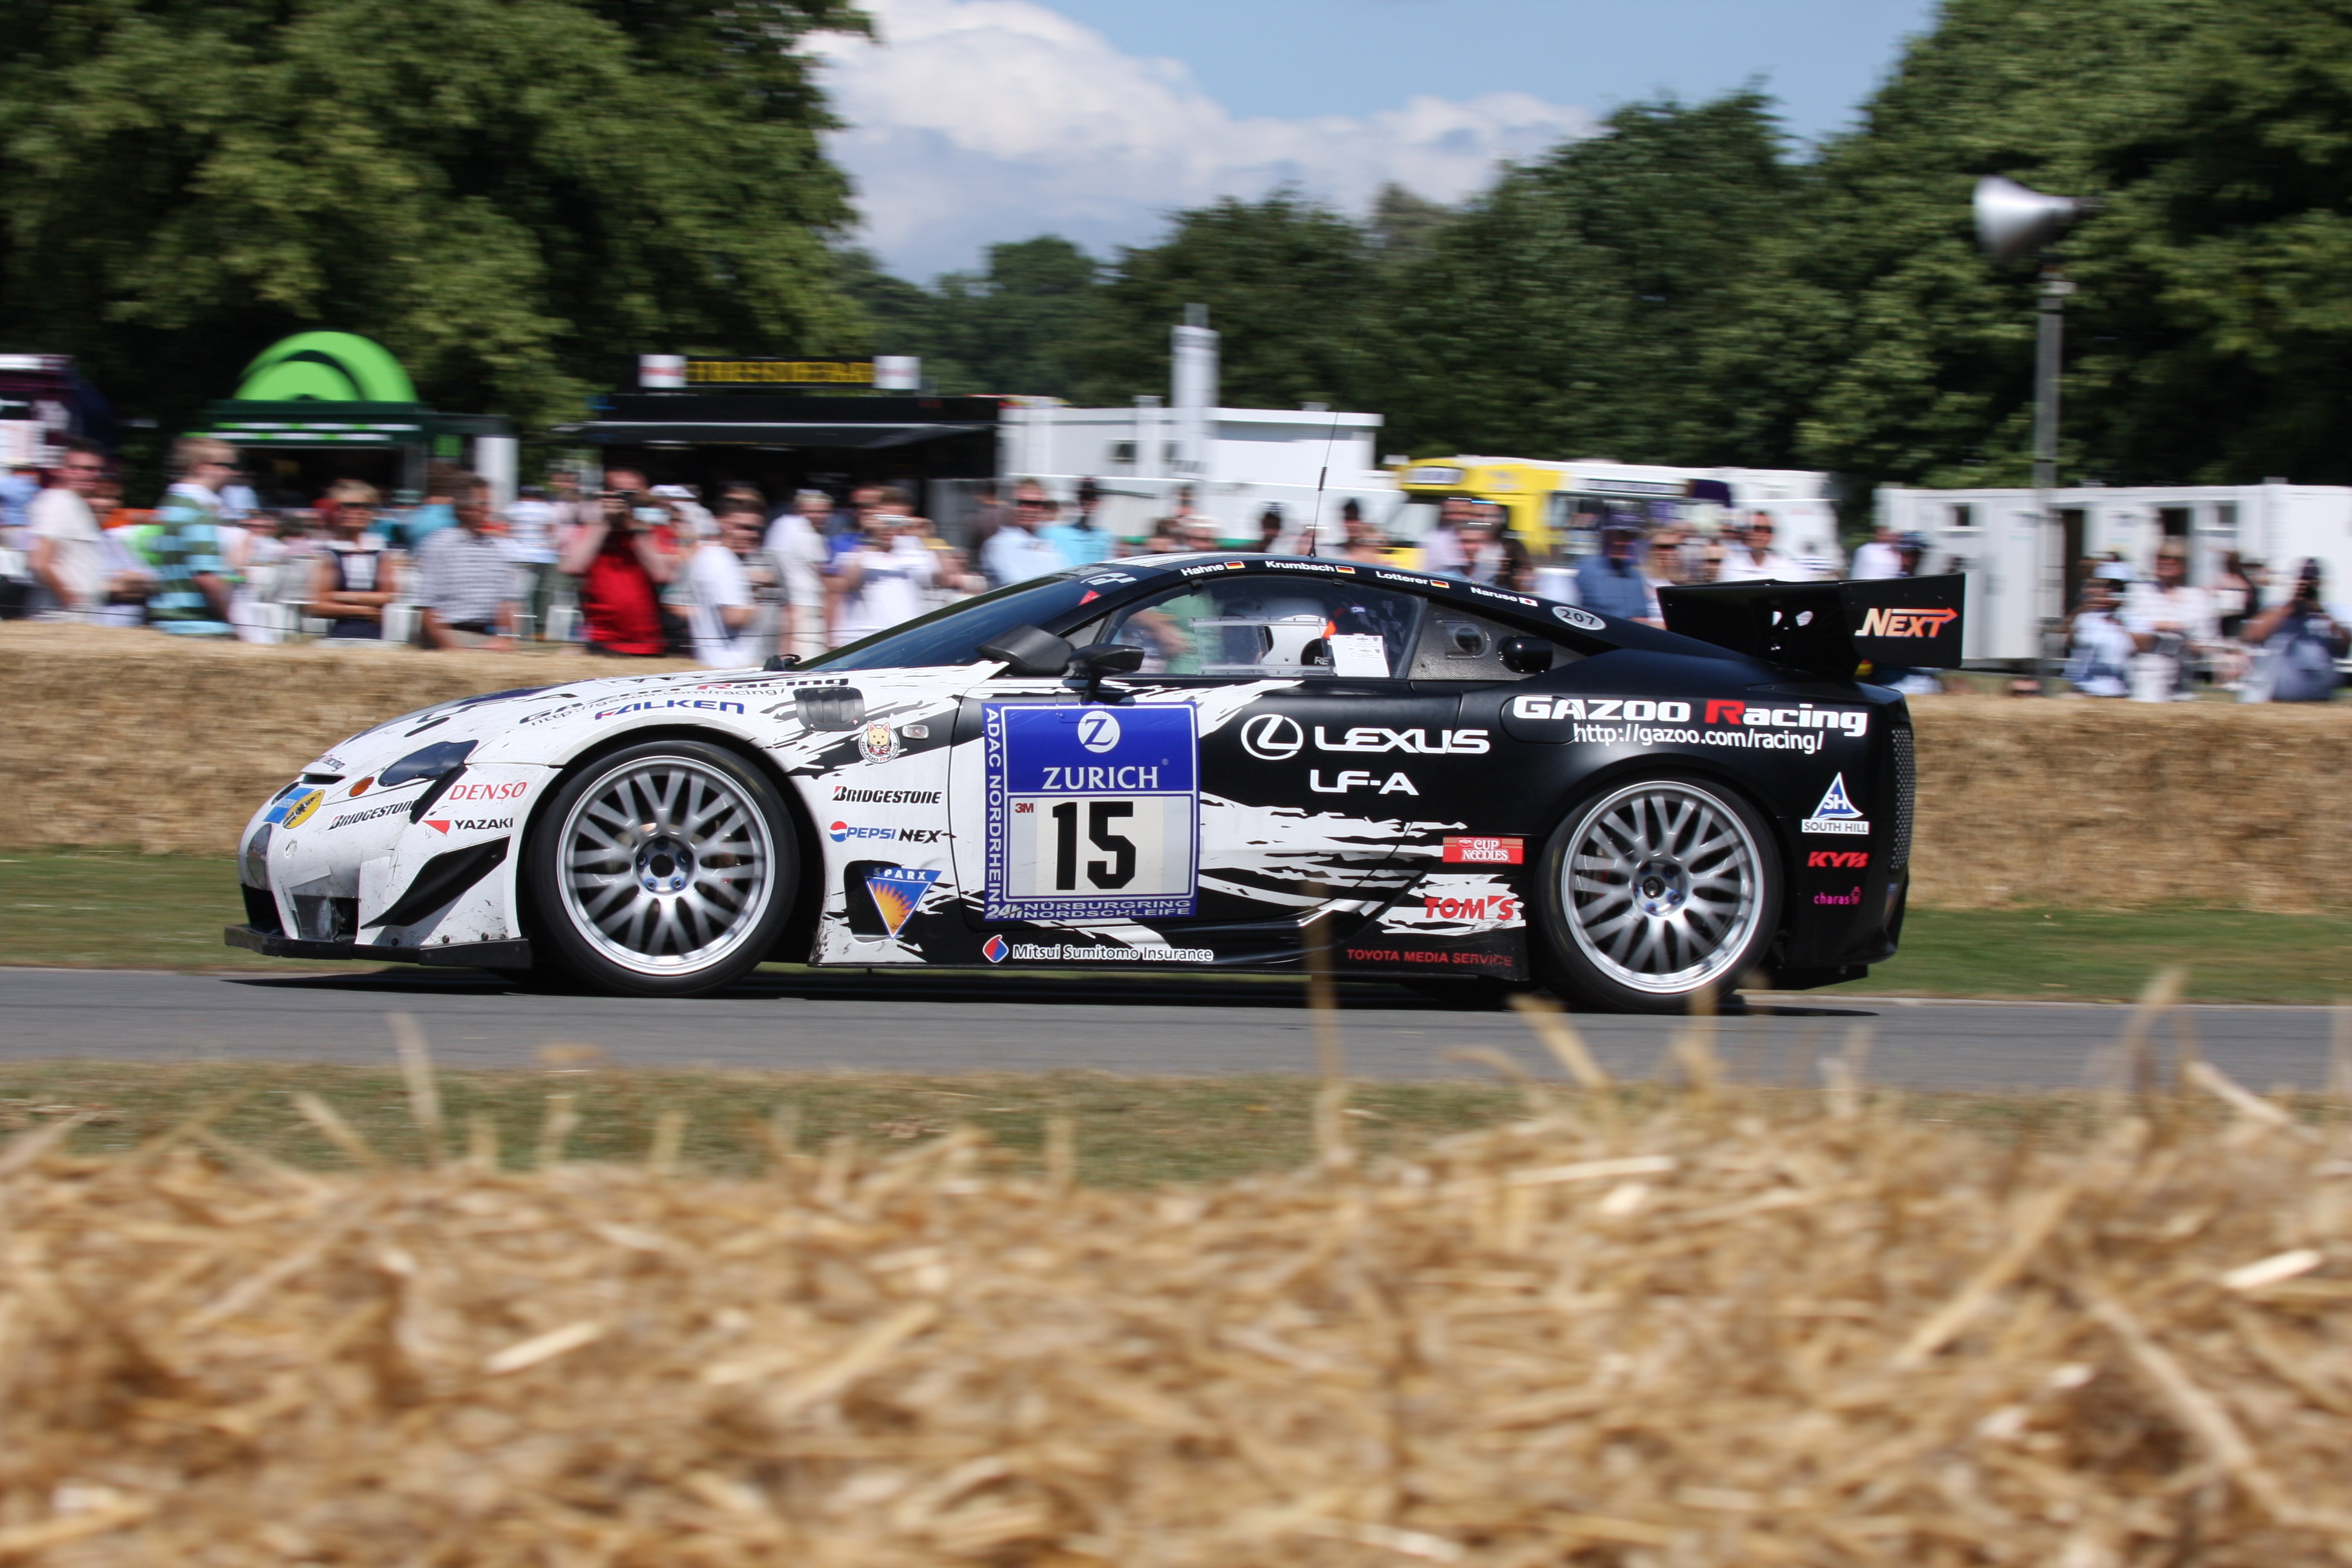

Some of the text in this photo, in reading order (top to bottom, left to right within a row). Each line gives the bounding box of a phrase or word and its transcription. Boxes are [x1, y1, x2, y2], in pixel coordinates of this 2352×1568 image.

[1180, 563, 1224, 576] Hahne
[1265, 560, 1334, 572] Krumbach
[1376, 571, 1428, 585] Lotterer
[1471, 587, 1517, 603] Naruse
[1561, 609, 1595, 626] 207
[1854, 607, 1958, 638] NEXT
[594, 699, 745, 720] FALKEN
[1513, 695, 1868, 737] GAZOO Racing
[1315, 727, 1490, 754] LEXUS
[1573, 724, 1824, 754] http://gazoo.com/racing/
[1042, 765, 1158, 790] ZURICH
[1310, 769, 1419, 795] LF-A
[449, 782, 527, 800] DENSO
[832, 786, 942, 804] BRIDGESTONE
[985, 707, 1002, 902] ADAC NORDRHEIN
[1015, 803, 1034, 814] 3M
[1824, 794, 1847, 809] SH
[327, 800, 413, 831] BRIDGESTON
[455, 818, 514, 830] YAZAKI
[846, 827, 944, 844] PEPSI NEX
[1804, 822, 1867, 832] SOUTH HILL
[1051, 801, 1137, 890] 15
[1474, 839, 1499, 849] CUP
[1807, 851, 1869, 867] KYB
[873, 867, 926, 880] SPARX
[1024, 900, 1191, 910] NÜRBURGRING
[1814, 892, 1850, 904] charas
[985, 904, 1022, 919] 24h
[1024, 908, 1190, 918] NORDSCHLEIFE
[1424, 895, 1515, 920] TOM'S
[1013, 944, 1214, 961] Mitsui Sumitomo Insurance
[1347, 949, 1513, 966] TOYOTA MEDIA SERVICE
